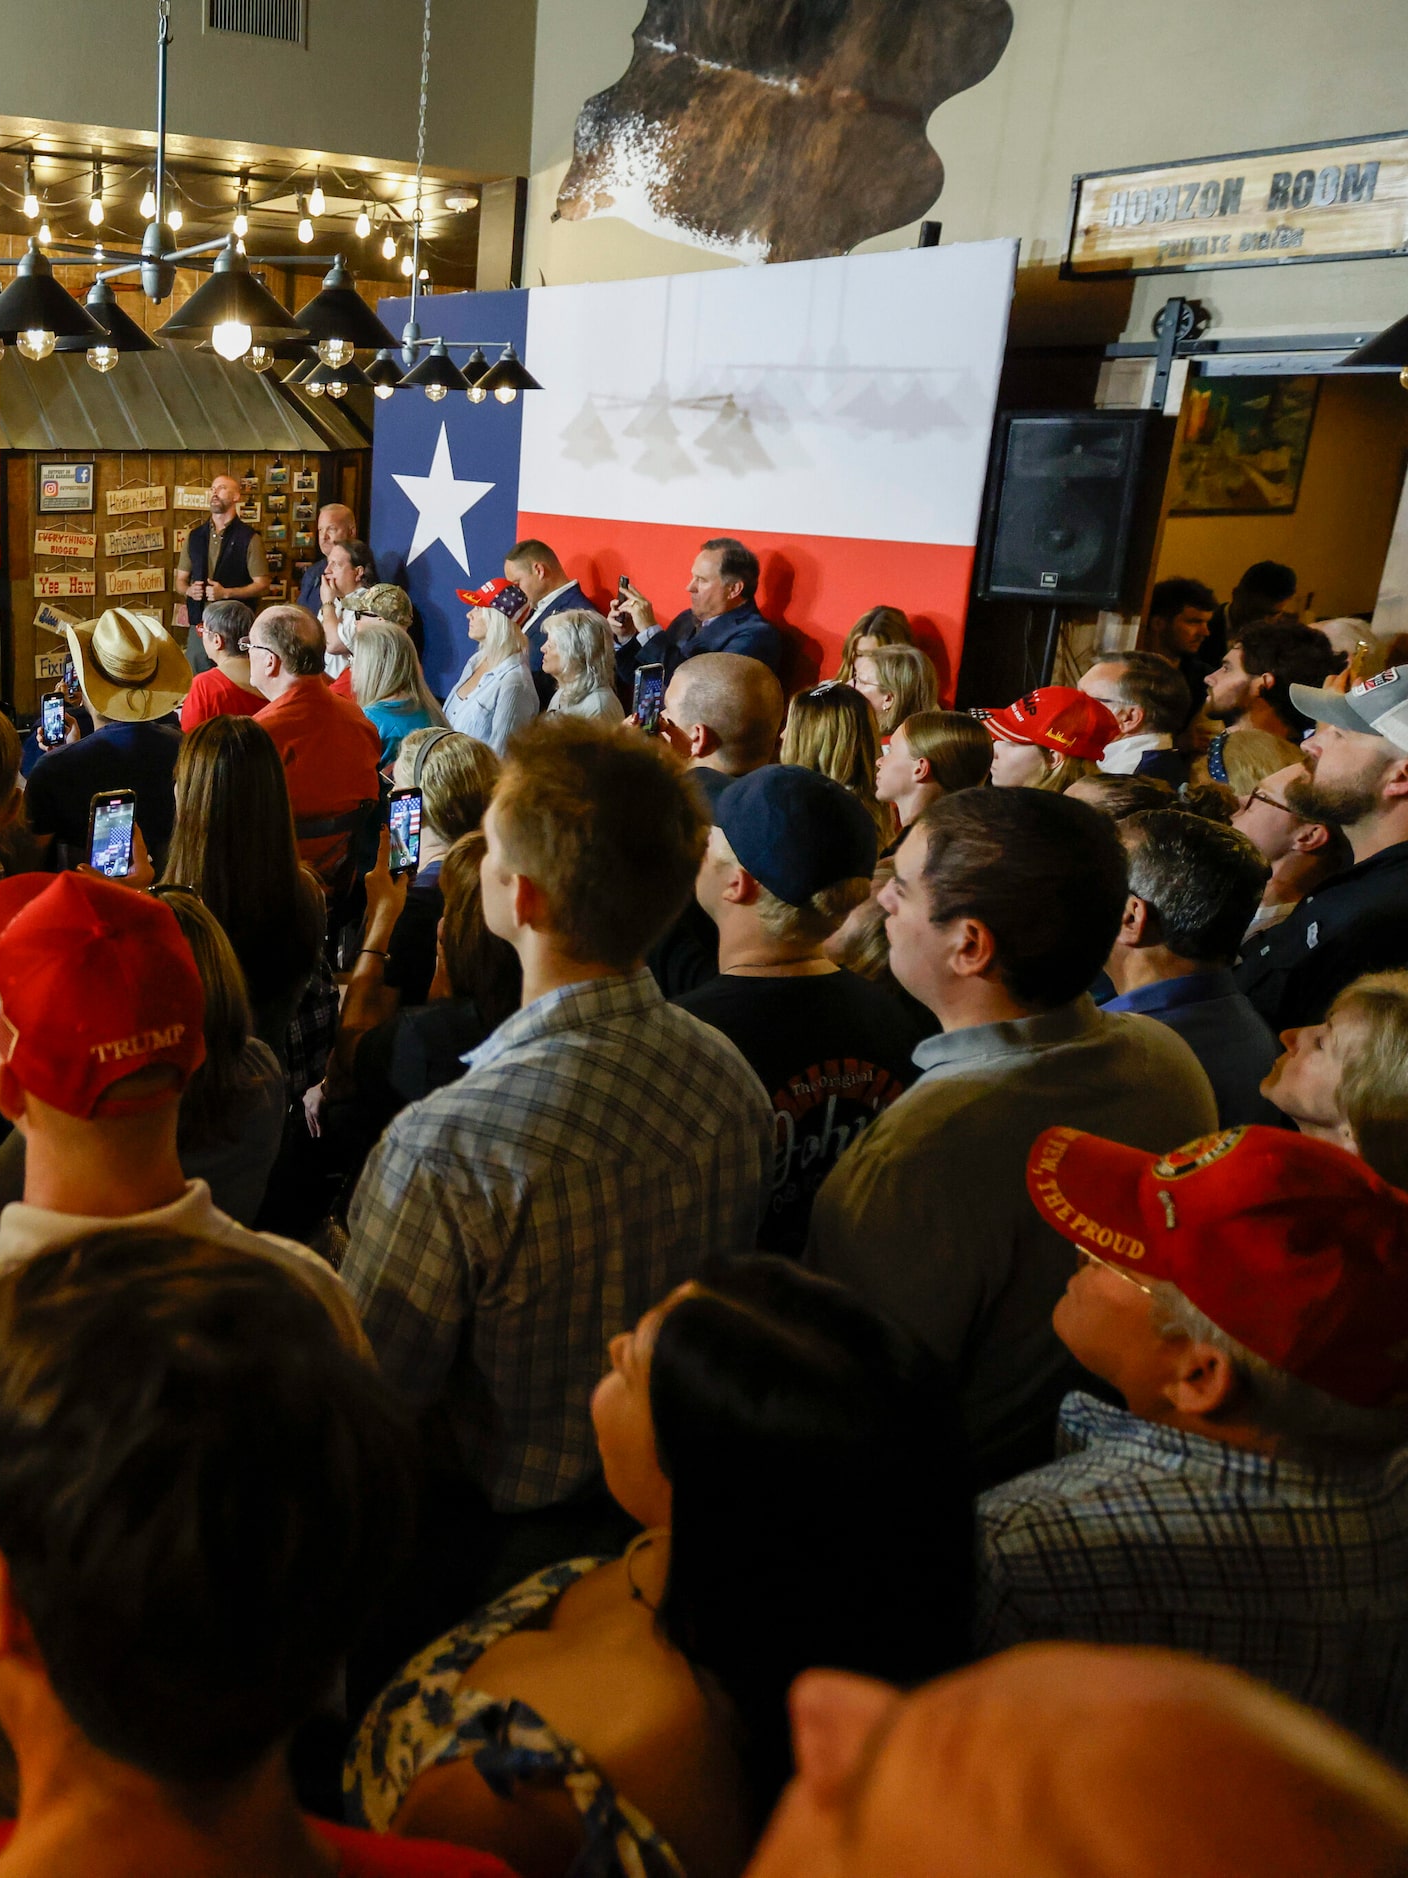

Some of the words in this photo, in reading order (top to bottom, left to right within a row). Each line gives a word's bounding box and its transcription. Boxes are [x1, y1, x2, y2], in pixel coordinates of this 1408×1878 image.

[1107, 177, 1245, 228] HORIZON
[1266, 161, 1381, 212] ROOM
[38, 532, 95, 545] EVERYTHING'S
[50, 546, 79, 556] BIGGER
[39, 576, 60, 594] Yee
[69, 576, 94, 594] Haw
[109, 573, 132, 593] Darn
[90, 1023, 185, 1063] TRUMP
[793, 1081, 817, 1096] The
[818, 1069, 874, 1089] Original
[1037, 1179, 1076, 1222] THE
[1068, 1215, 1146, 1260] PROUD
